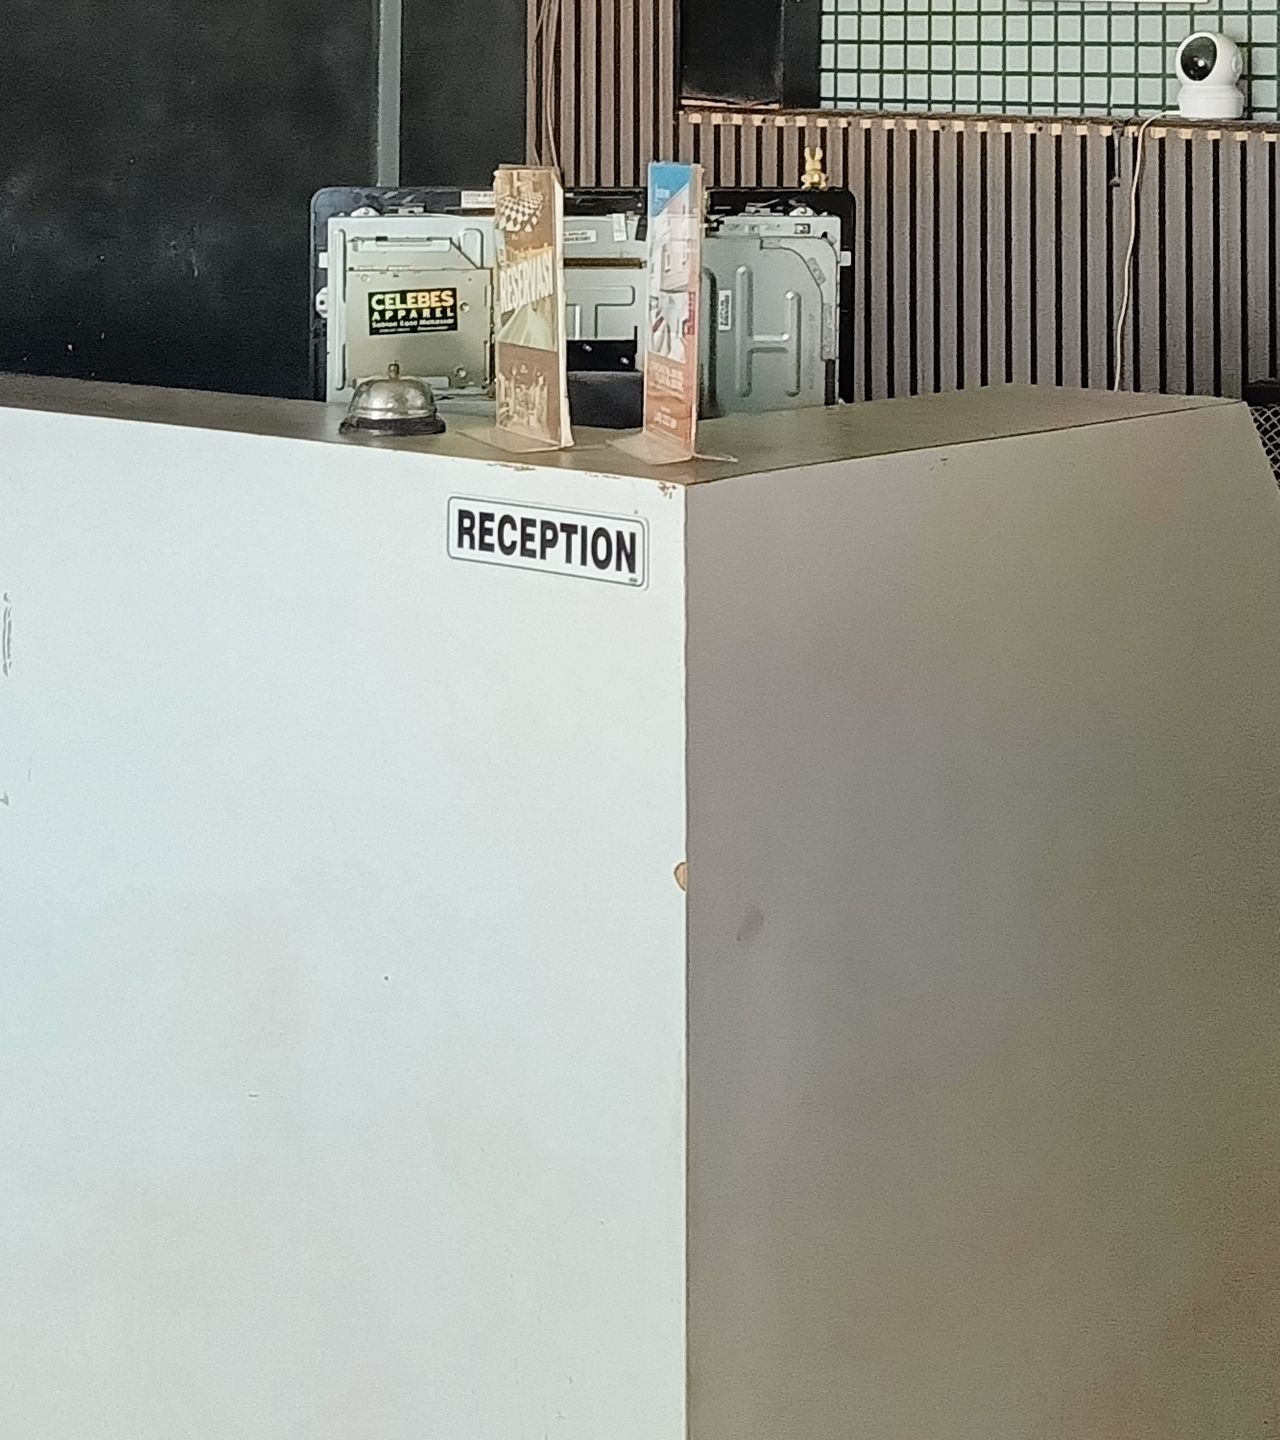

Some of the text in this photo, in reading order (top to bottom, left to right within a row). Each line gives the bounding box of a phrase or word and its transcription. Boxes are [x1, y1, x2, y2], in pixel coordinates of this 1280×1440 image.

[371, 290, 455, 311] CELEBES
[372, 308, 455, 321] APPAREL
[457, 508, 637, 574] RECEPTION
